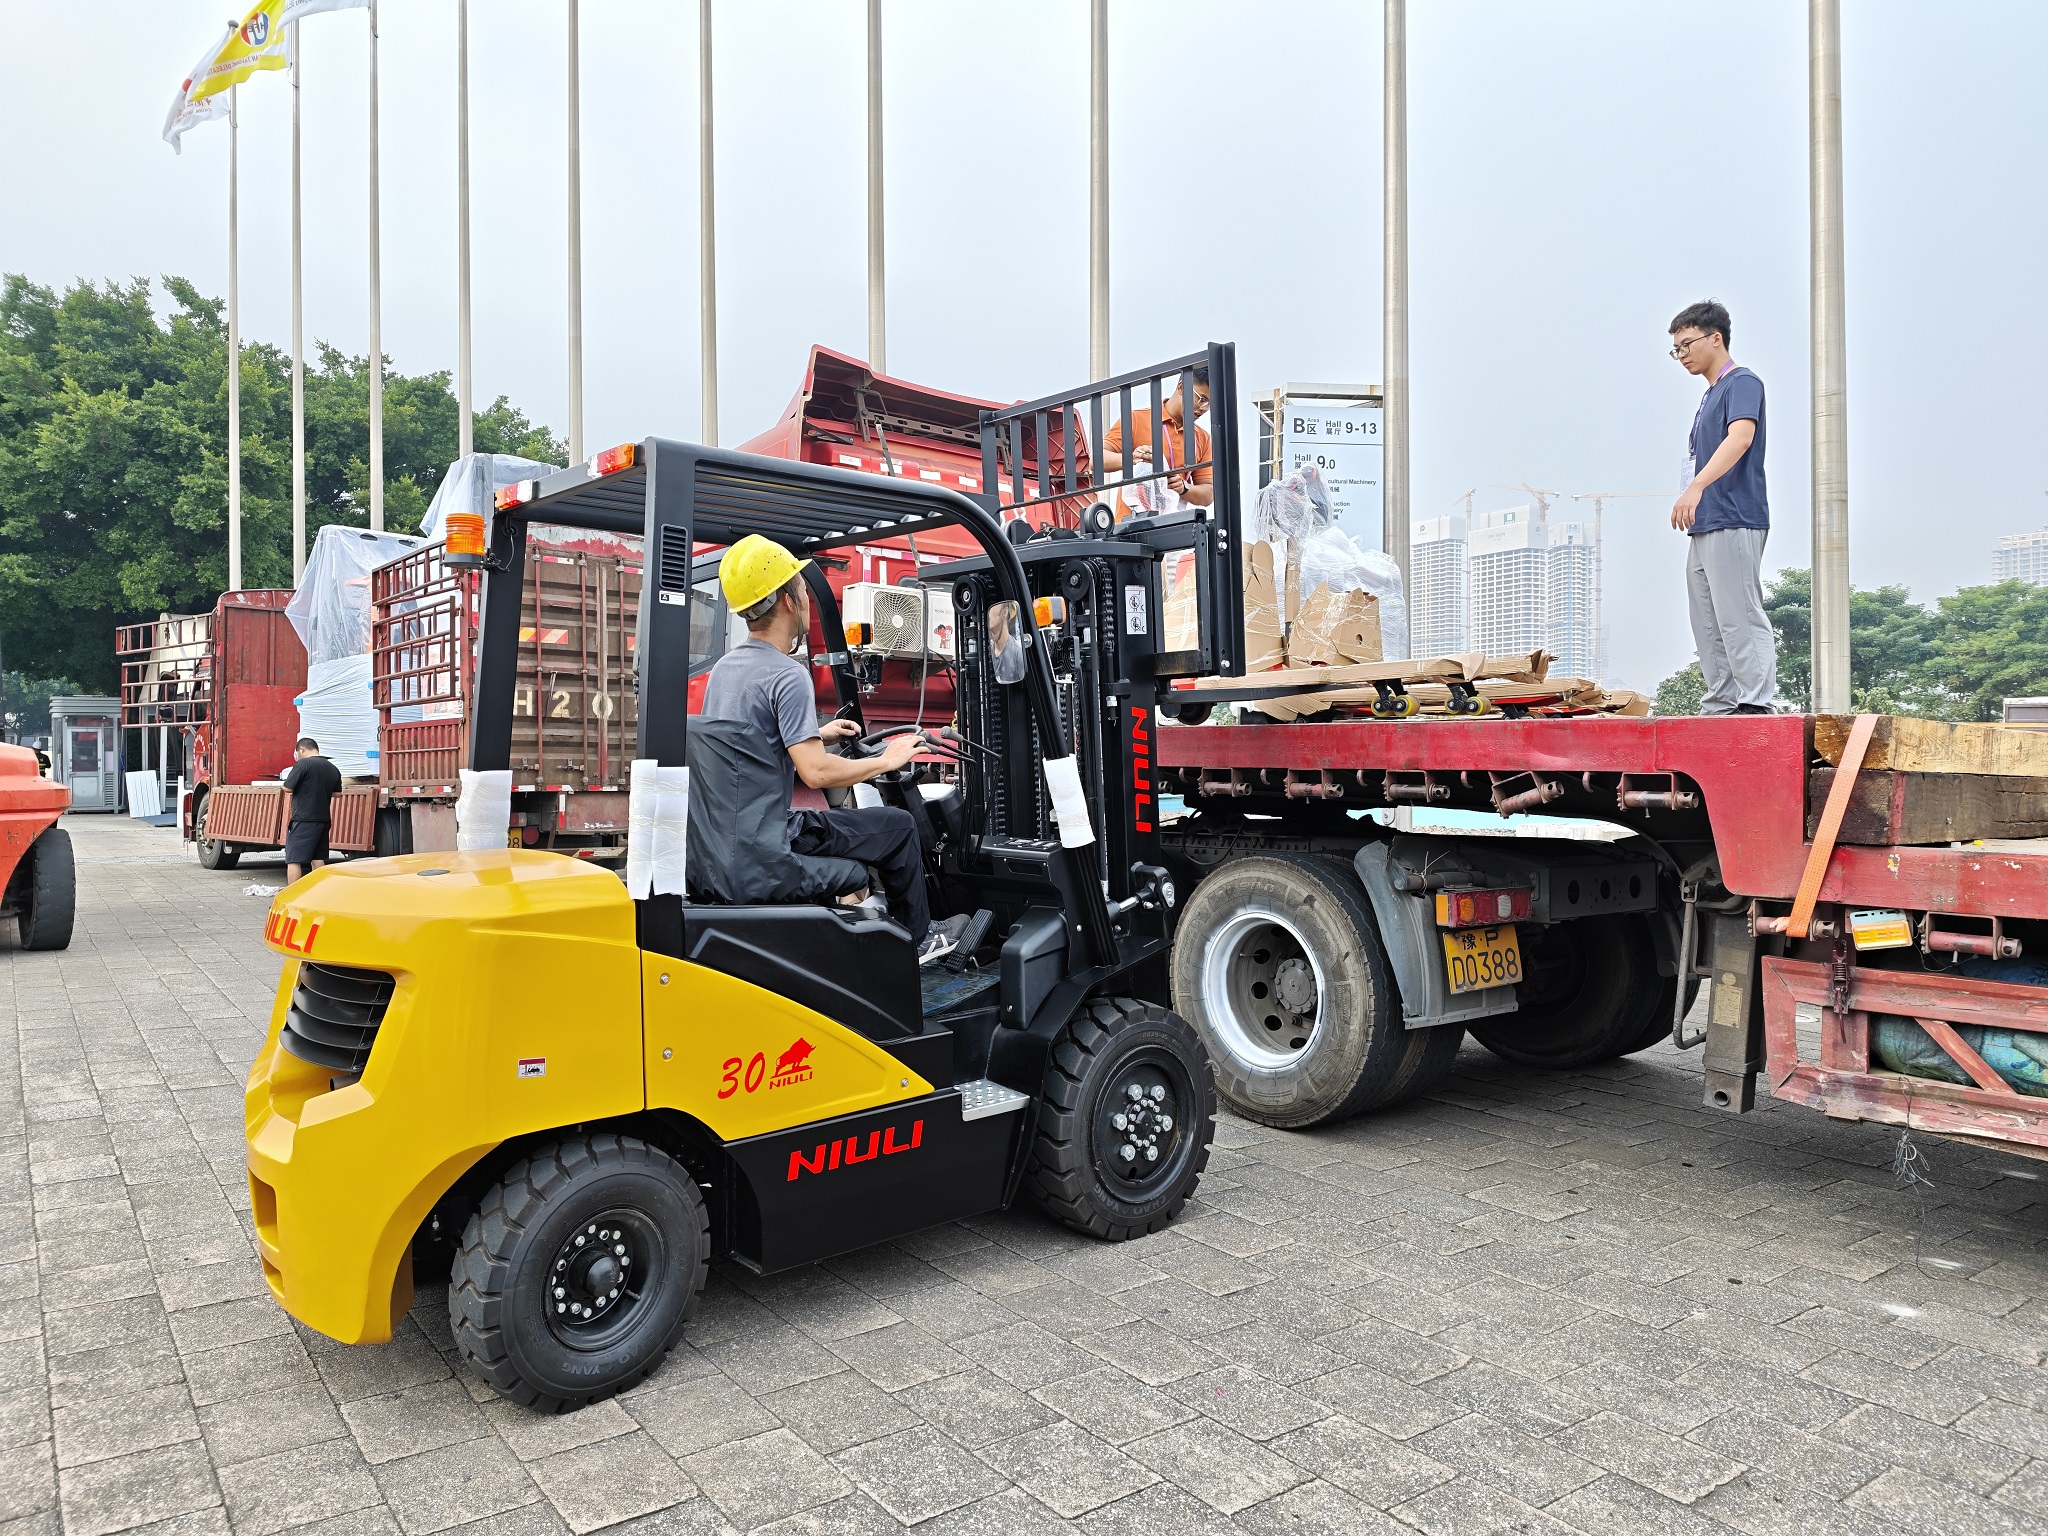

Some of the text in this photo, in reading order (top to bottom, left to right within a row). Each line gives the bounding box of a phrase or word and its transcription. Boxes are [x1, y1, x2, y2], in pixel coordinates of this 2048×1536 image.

[1325, 420, 1342, 428] Hall
[1345, 421, 1377, 435] 9-13
[1325, 427, 1342, 436] 展厅
[1294, 453, 1336, 470] Hall 9.0
[1131, 706, 1152, 833] NIULI
[1451, 947, 1519, 990] D0388
[717, 1051, 766, 1100] 30
[769, 1071, 814, 1090] NIULI
[787, 1119, 924, 1182] NIULI
[1092, 1182, 1168, 1215] CHAO YANG
[561, 1361, 601, 1376] YANG
